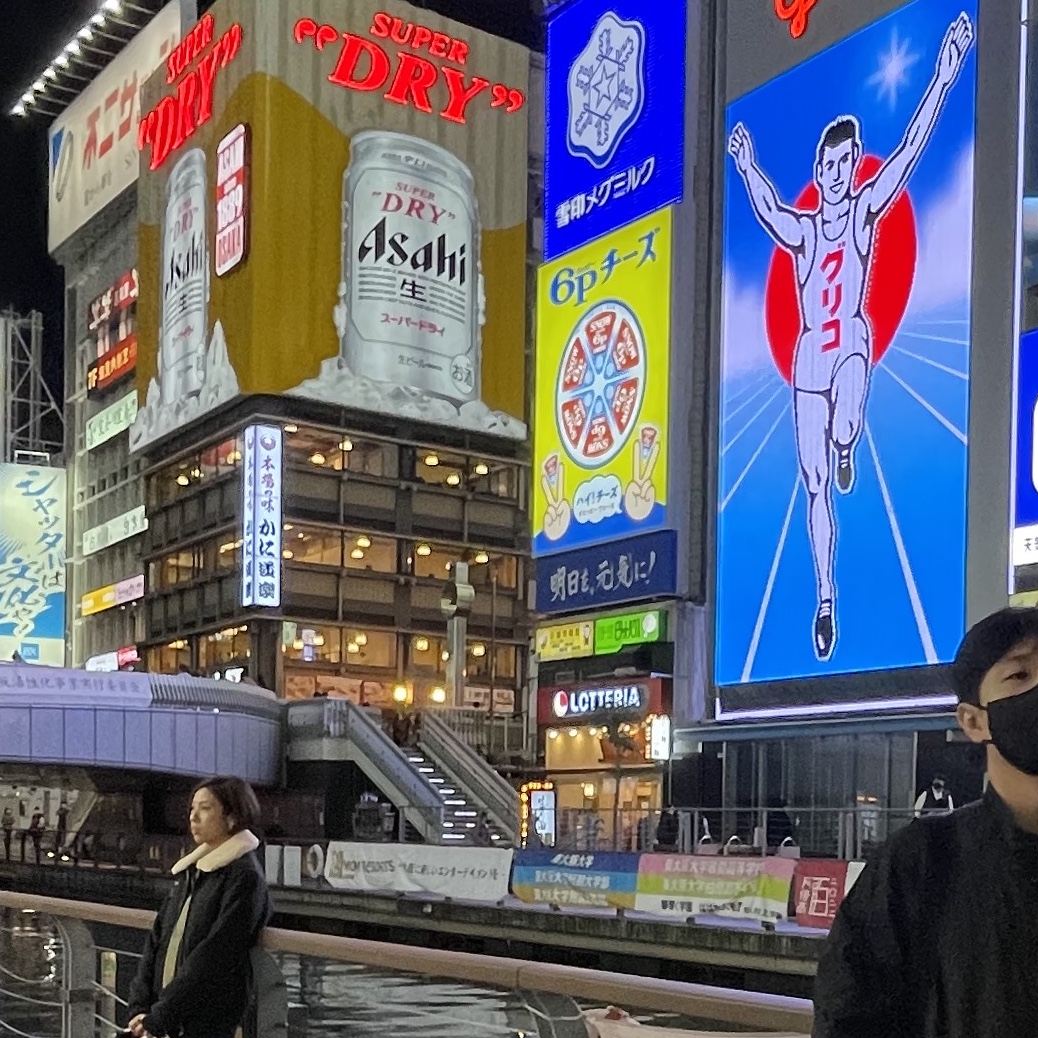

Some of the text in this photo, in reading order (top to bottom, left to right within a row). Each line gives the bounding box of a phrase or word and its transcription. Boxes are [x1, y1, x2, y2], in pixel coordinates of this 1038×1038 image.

[167, 14, 214, 84] SUPER
[371, 12, 471, 65] SUPER
[395, 181, 435, 201] SUPER
[555, 156, 656, 229] 雪印メグミルク
[358, 216, 466, 286] Asahi
[400, 279, 428, 302] 生
[820, 241, 846, 353] グリコ
[570, 686, 640, 713] LOTTERIA
